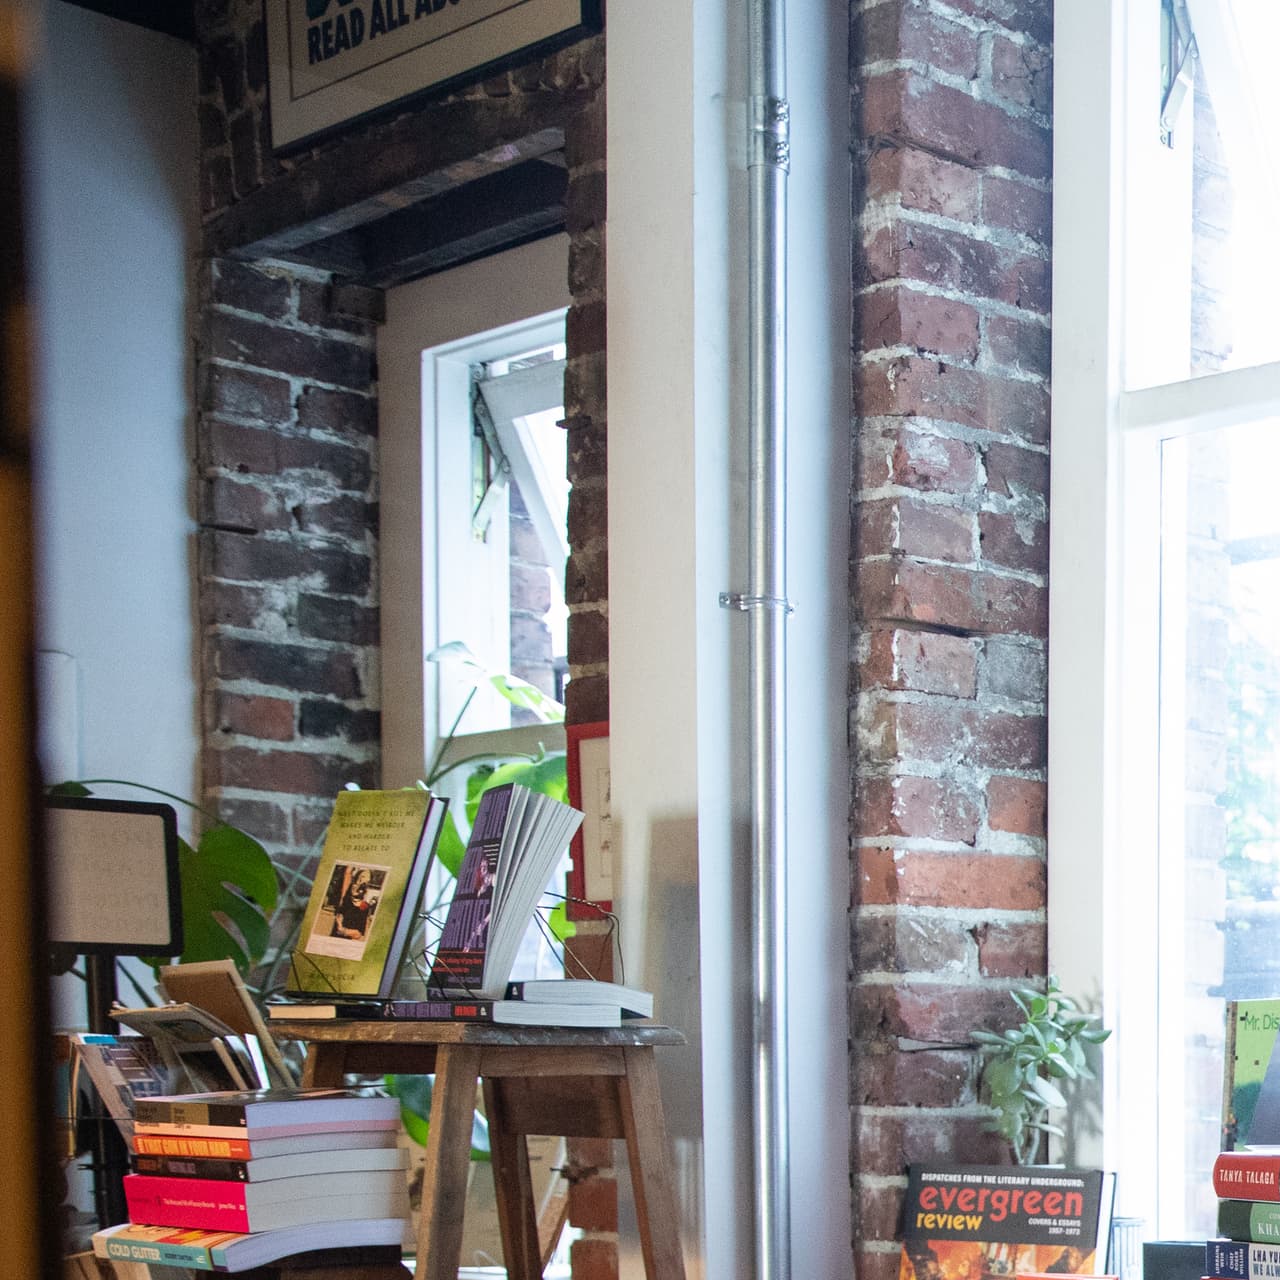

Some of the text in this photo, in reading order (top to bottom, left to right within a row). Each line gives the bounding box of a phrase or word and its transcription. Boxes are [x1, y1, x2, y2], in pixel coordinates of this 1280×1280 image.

[307, 9, 365, 65] READ
[370, 0, 411, 40] ALL
[921, 1172, 1084, 1188] DISPATCHES FROM THE LITERARY UNDERGROUND:
[1219, 1169, 1275, 1185] TANYA TALAGA
[918, 1186, 1084, 1222] evergreen
[916, 1213, 983, 1231] review
[1253, 1249, 1267, 1262] LHA
[1253, 1263, 1265, 1276] WE
